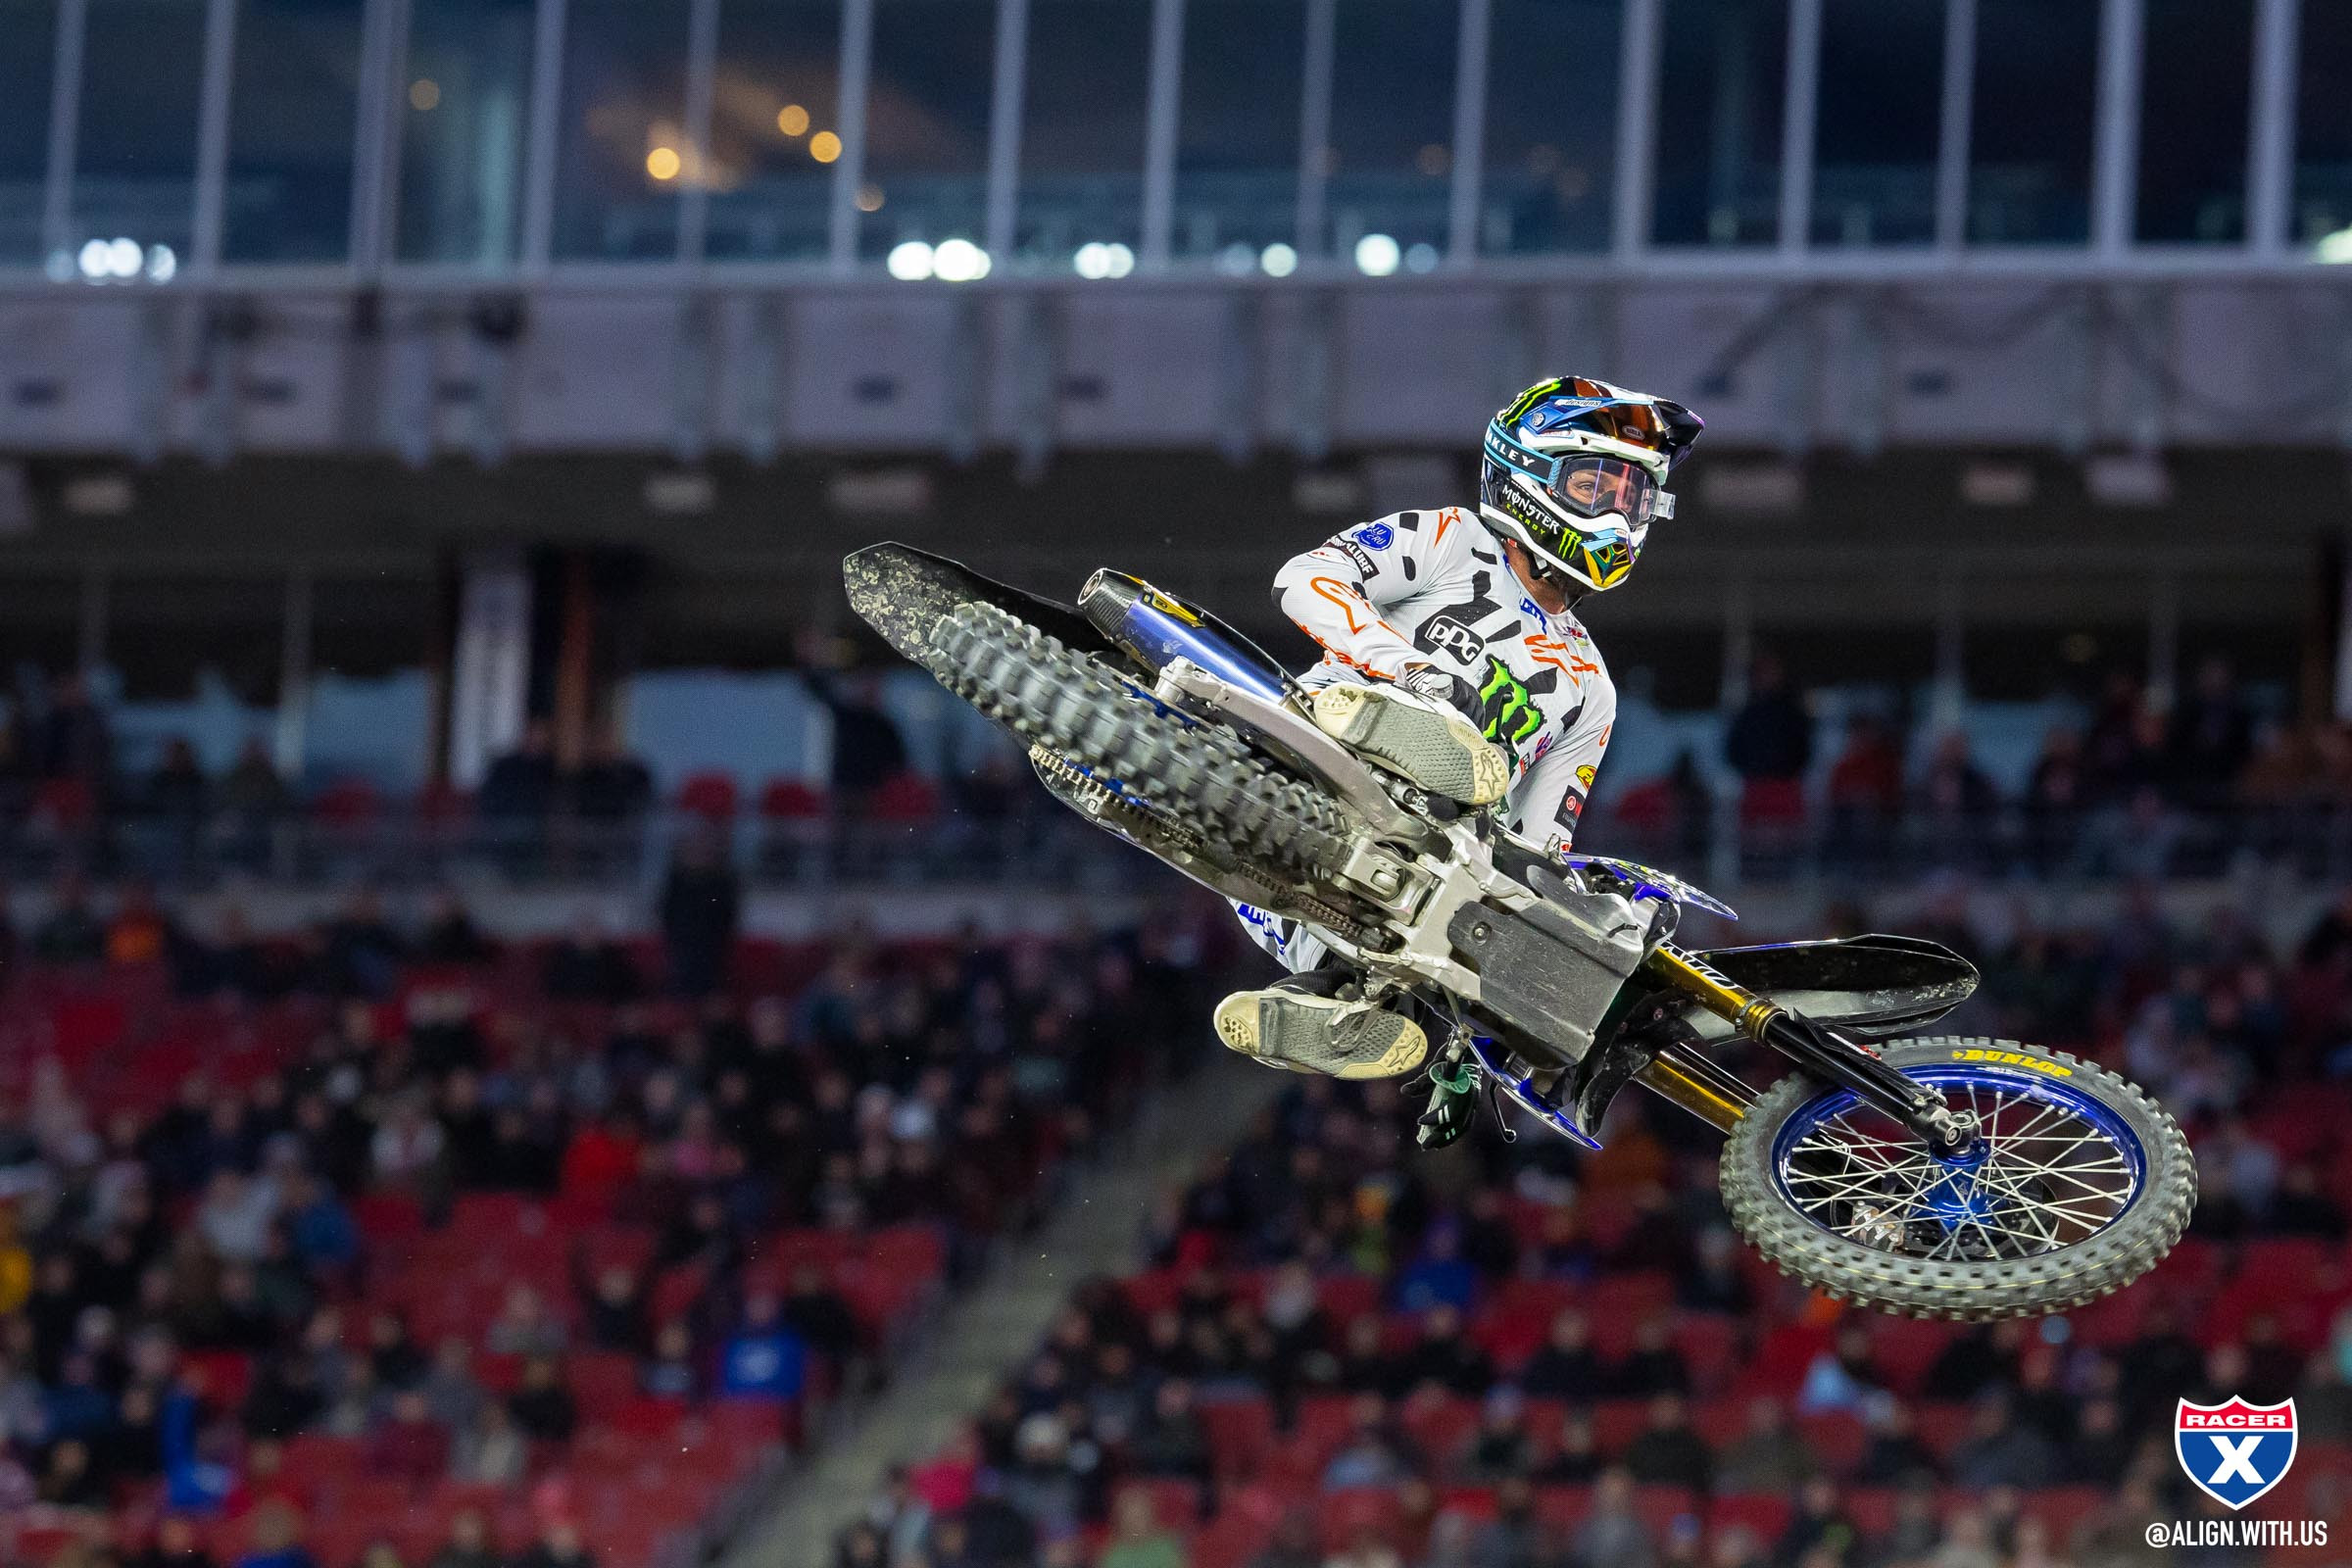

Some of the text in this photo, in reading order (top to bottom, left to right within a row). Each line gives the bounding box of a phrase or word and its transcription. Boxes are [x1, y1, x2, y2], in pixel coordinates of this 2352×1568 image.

[1501, 484, 1558, 535] MONSTER
[1506, 503, 1546, 535] ENERGY
[1428, 622, 1482, 662] PPG
[1962, 1049, 2073, 1077] DUNLOP
